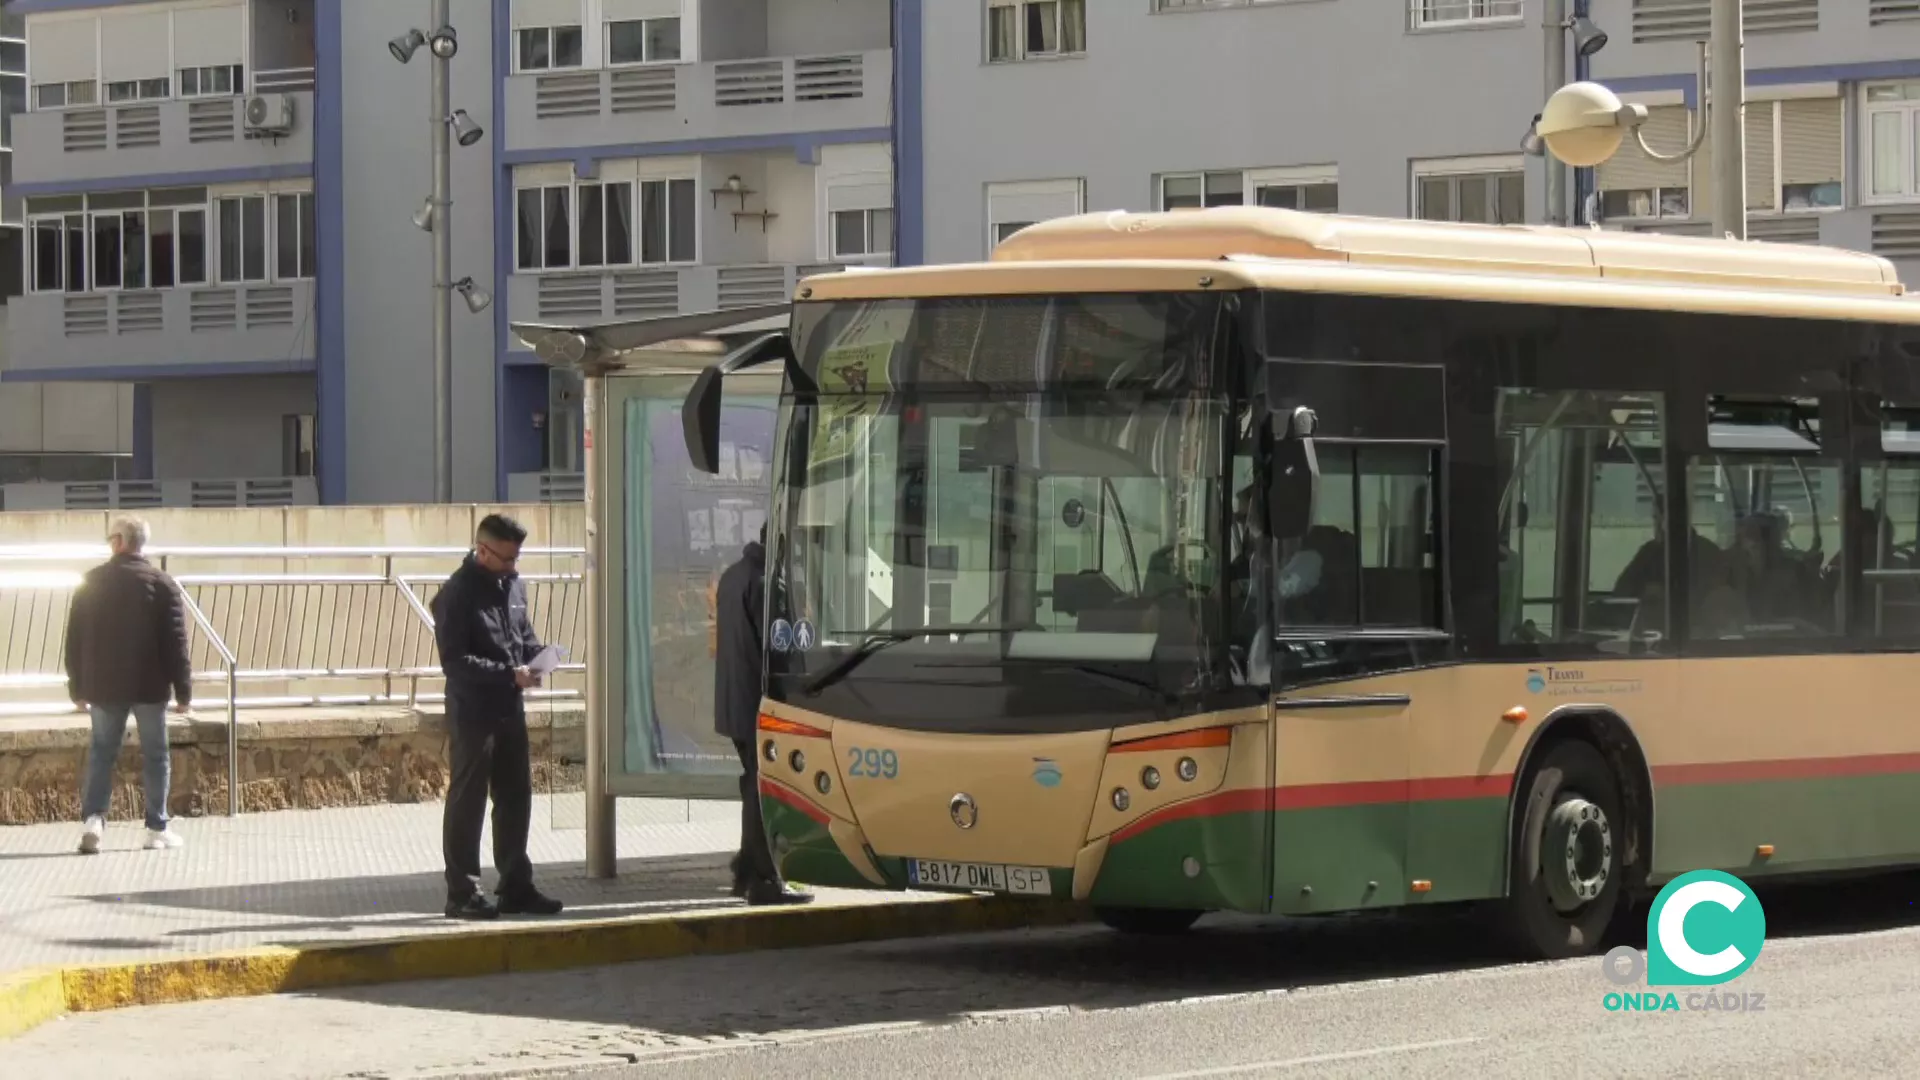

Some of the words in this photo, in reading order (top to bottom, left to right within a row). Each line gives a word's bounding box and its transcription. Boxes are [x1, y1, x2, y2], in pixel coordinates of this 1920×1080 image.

[847, 747, 898, 779] 299
[917, 862, 961, 884] 5817
[967, 866, 1001, 889] DML
[1013, 869, 1043, 891] SP
